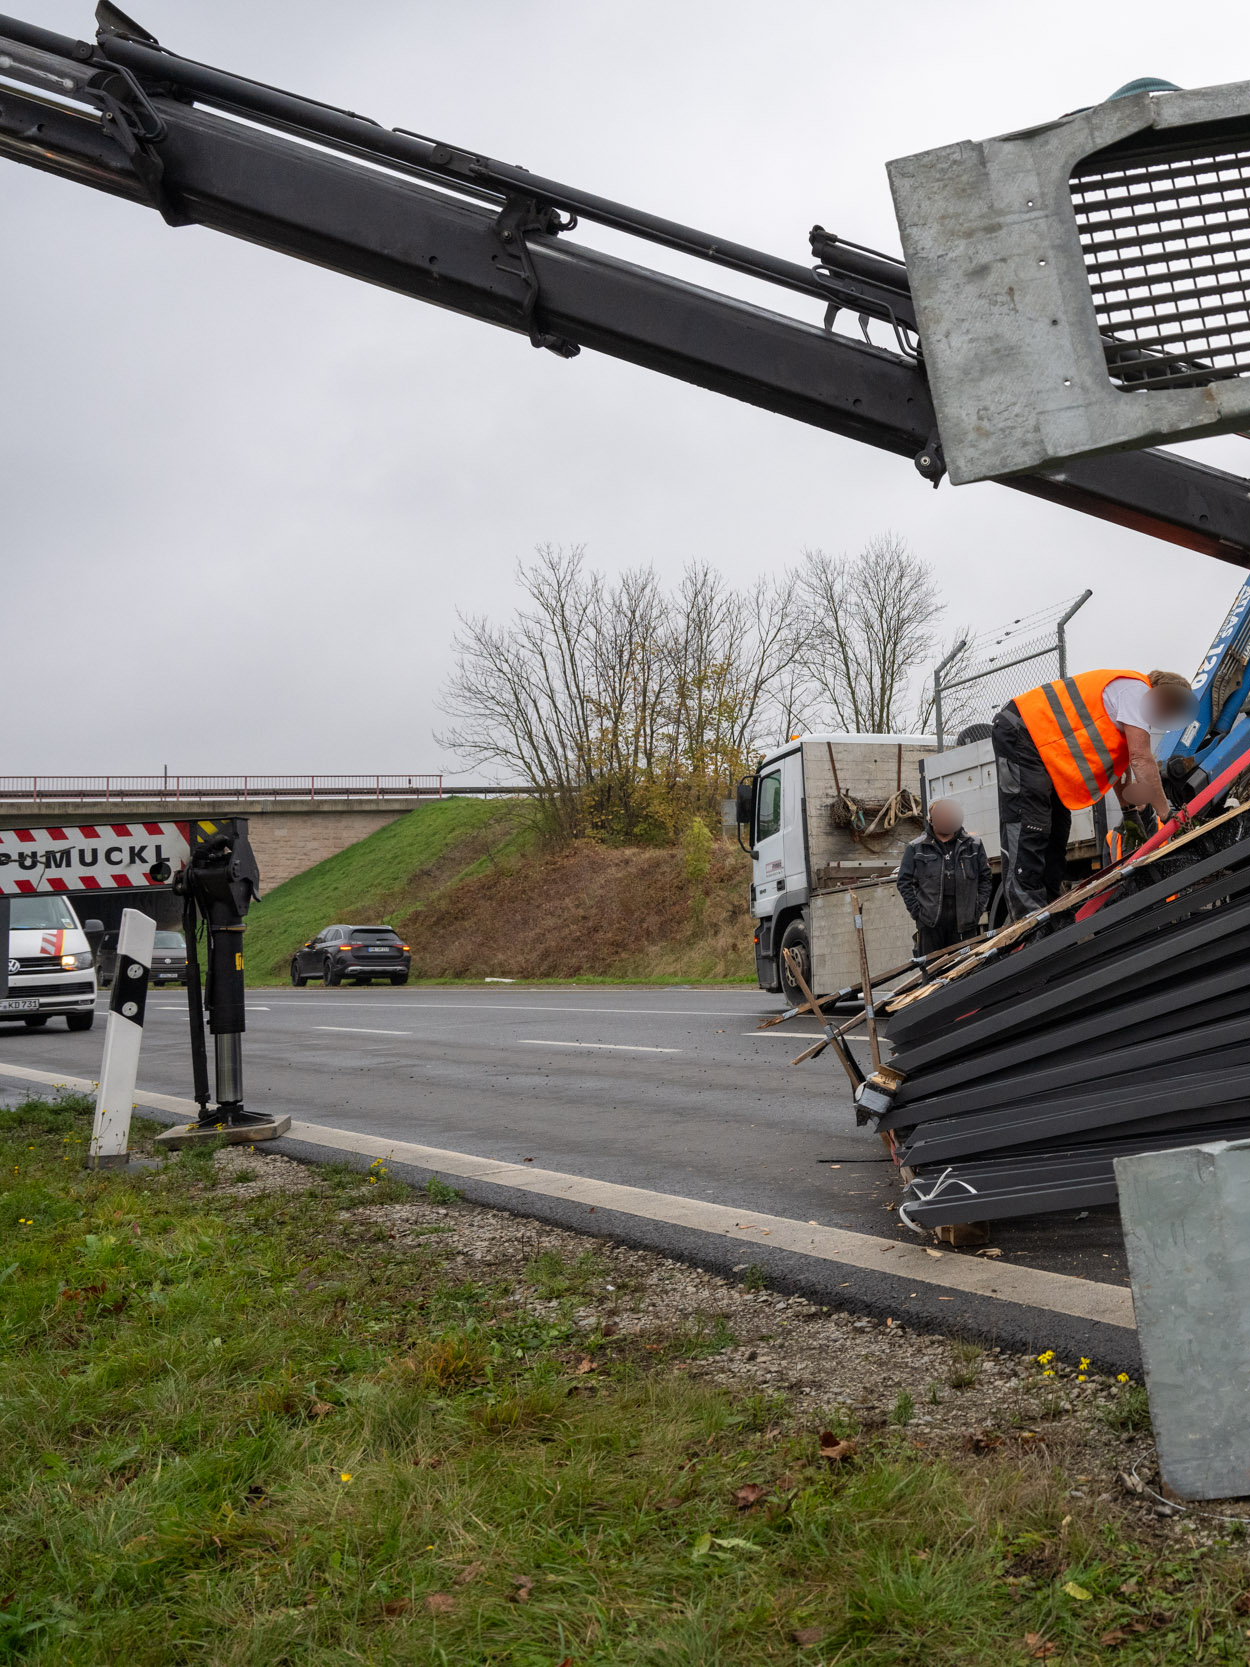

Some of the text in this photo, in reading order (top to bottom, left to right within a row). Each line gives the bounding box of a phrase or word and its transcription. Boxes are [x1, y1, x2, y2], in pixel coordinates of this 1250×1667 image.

[1190, 642, 1226, 691] 120
[0, 844, 171, 871] PUMUCKL
[21, 1000, 38, 1008] 731
